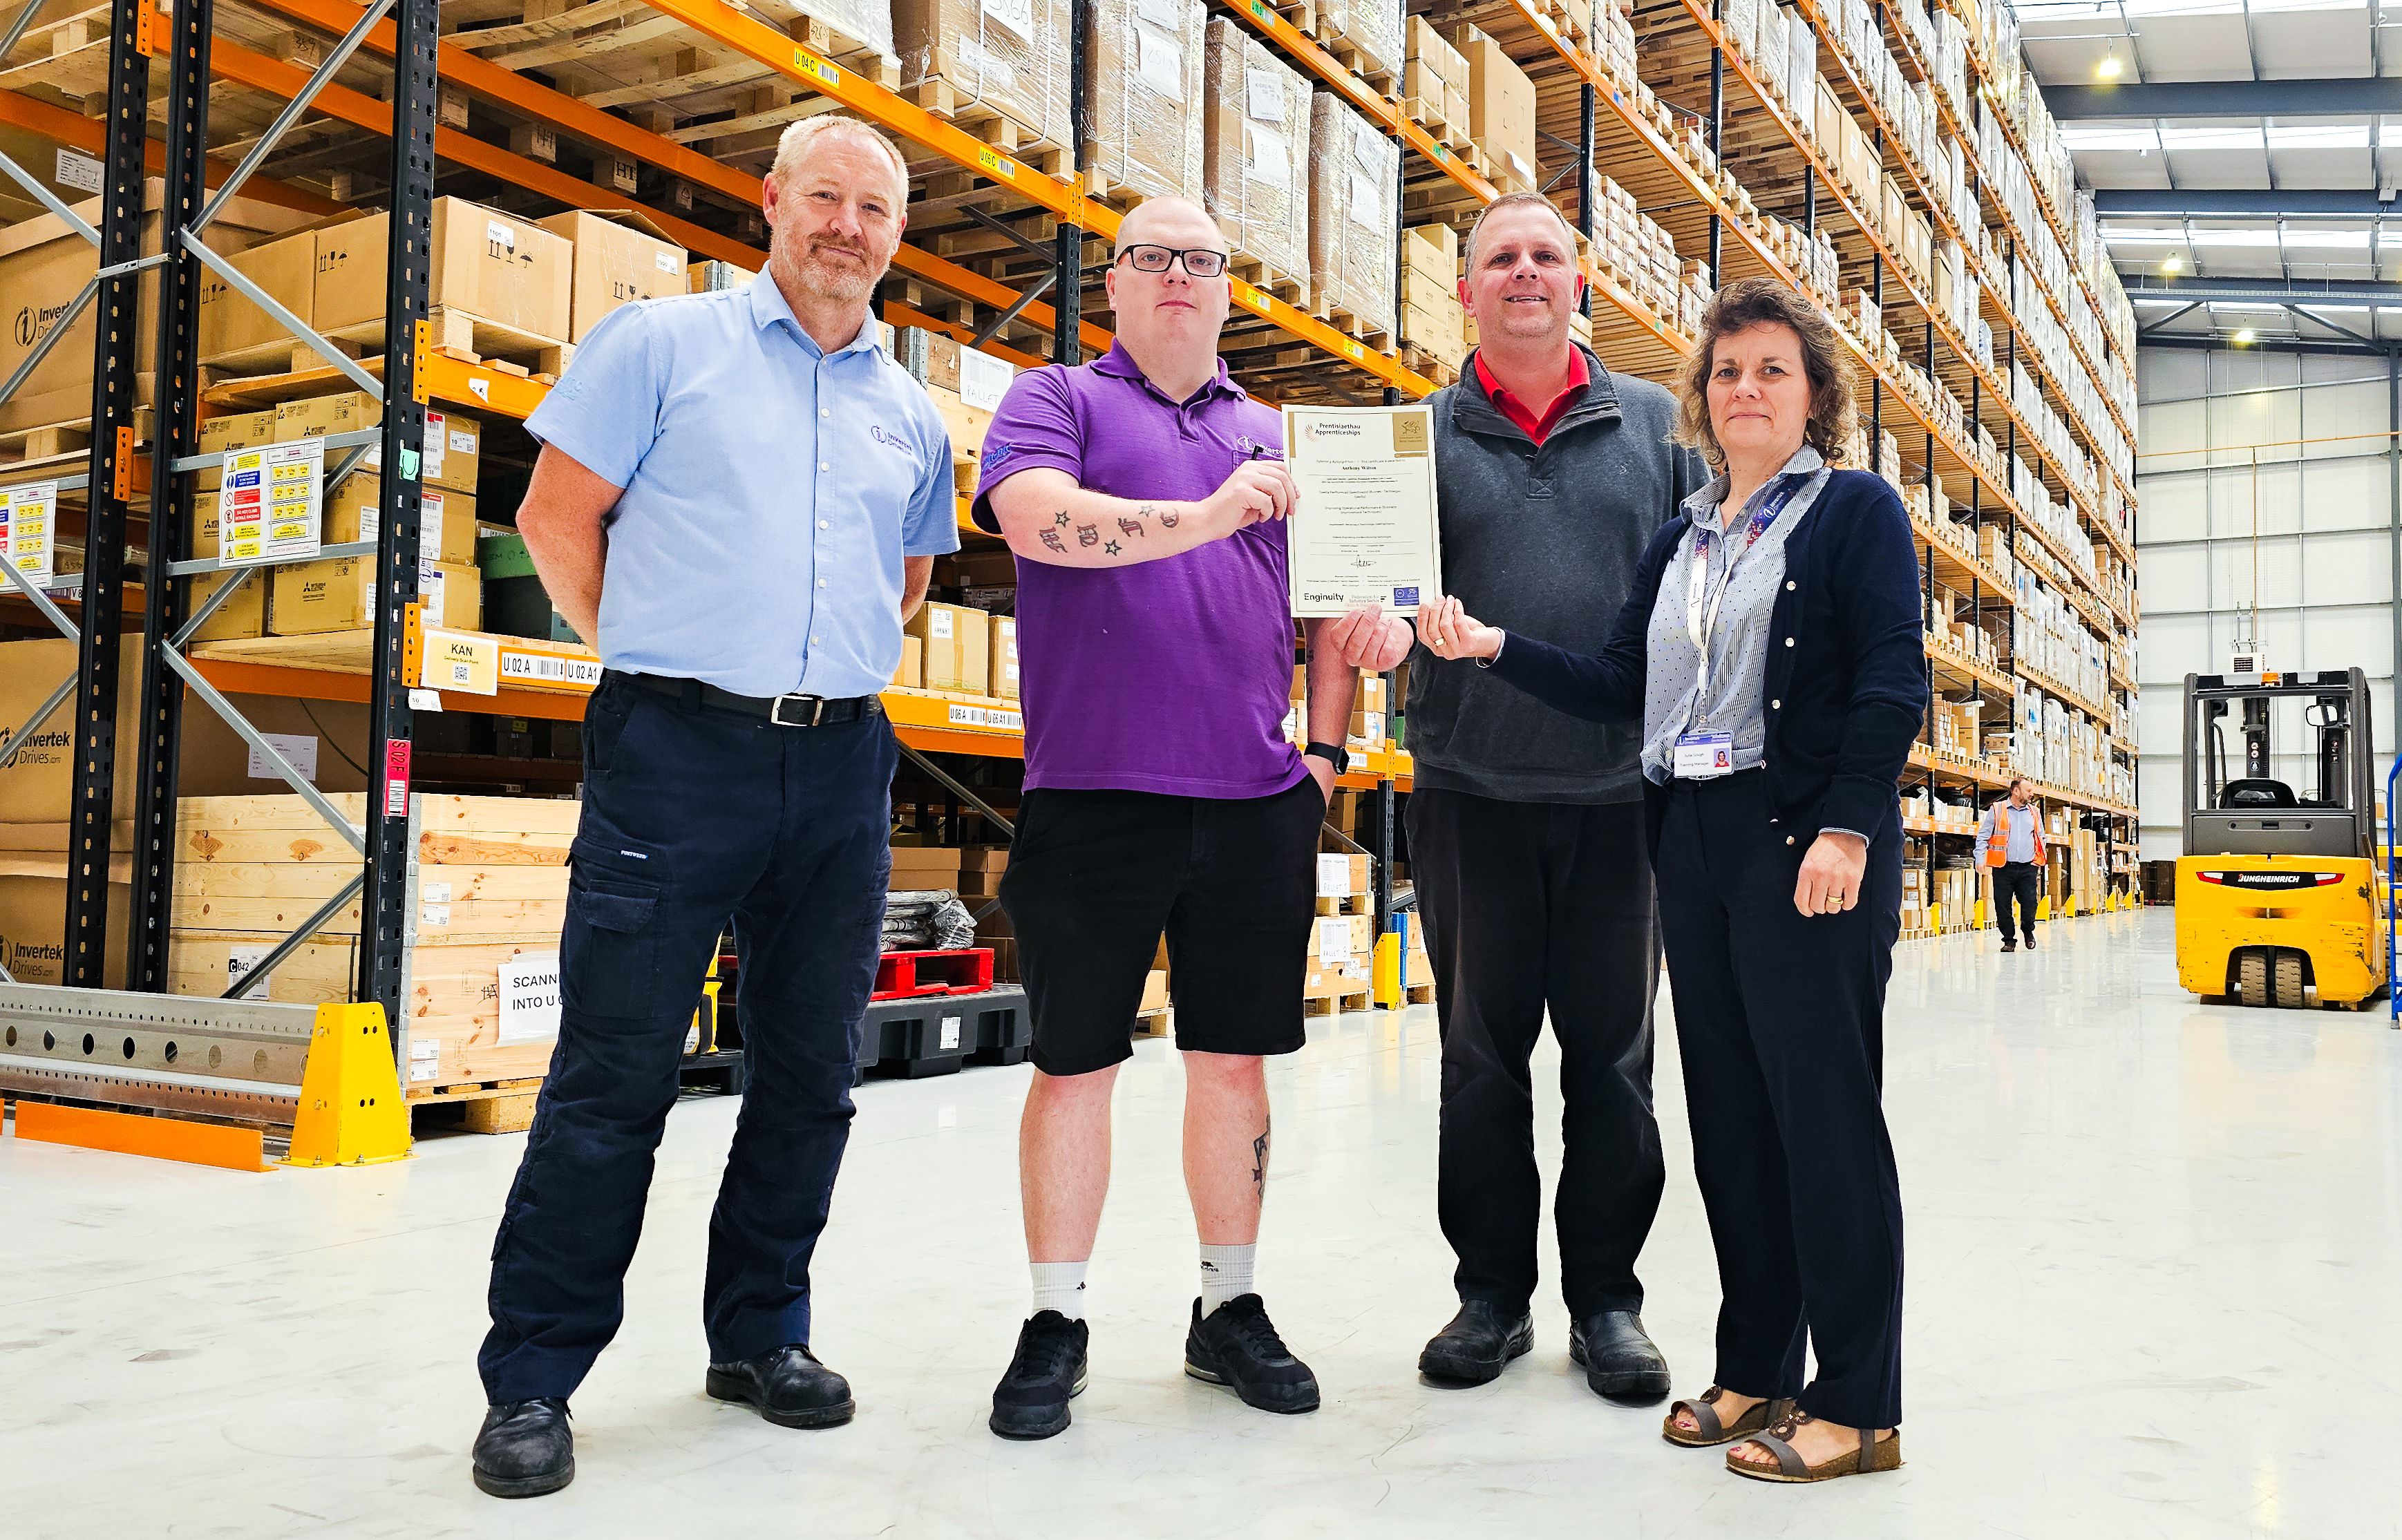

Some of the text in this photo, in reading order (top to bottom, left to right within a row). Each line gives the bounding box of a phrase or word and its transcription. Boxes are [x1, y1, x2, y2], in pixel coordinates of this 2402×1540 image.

[795, 51, 800, 65] U
[811, 59, 815, 72] C
[981, 149, 984, 161] U
[992, 155, 996, 167] C
[616, 161, 636, 182] HT
[72, 589, 77, 598] V
[1304, 593, 1344, 602] Enginuity
[451, 643, 473, 656] KAN
[504, 657, 531, 673] U 02 A
[568, 664, 596, 680] U 02 A1
[950, 708, 954, 719] U
[962, 710, 966, 720] A
[987, 712, 992, 723] U
[999, 714, 1005, 725] A1
[390, 751, 406, 763] 02
[2238, 873, 2300, 883] JUNGHEINRICH
[1323, 882, 1342, 892] PALLET
[15, 942, 64, 960] Invertek
[238, 962, 249, 971] 042
[513, 973, 560, 988] SCANN
[513, 996, 555, 1010] INTO U
